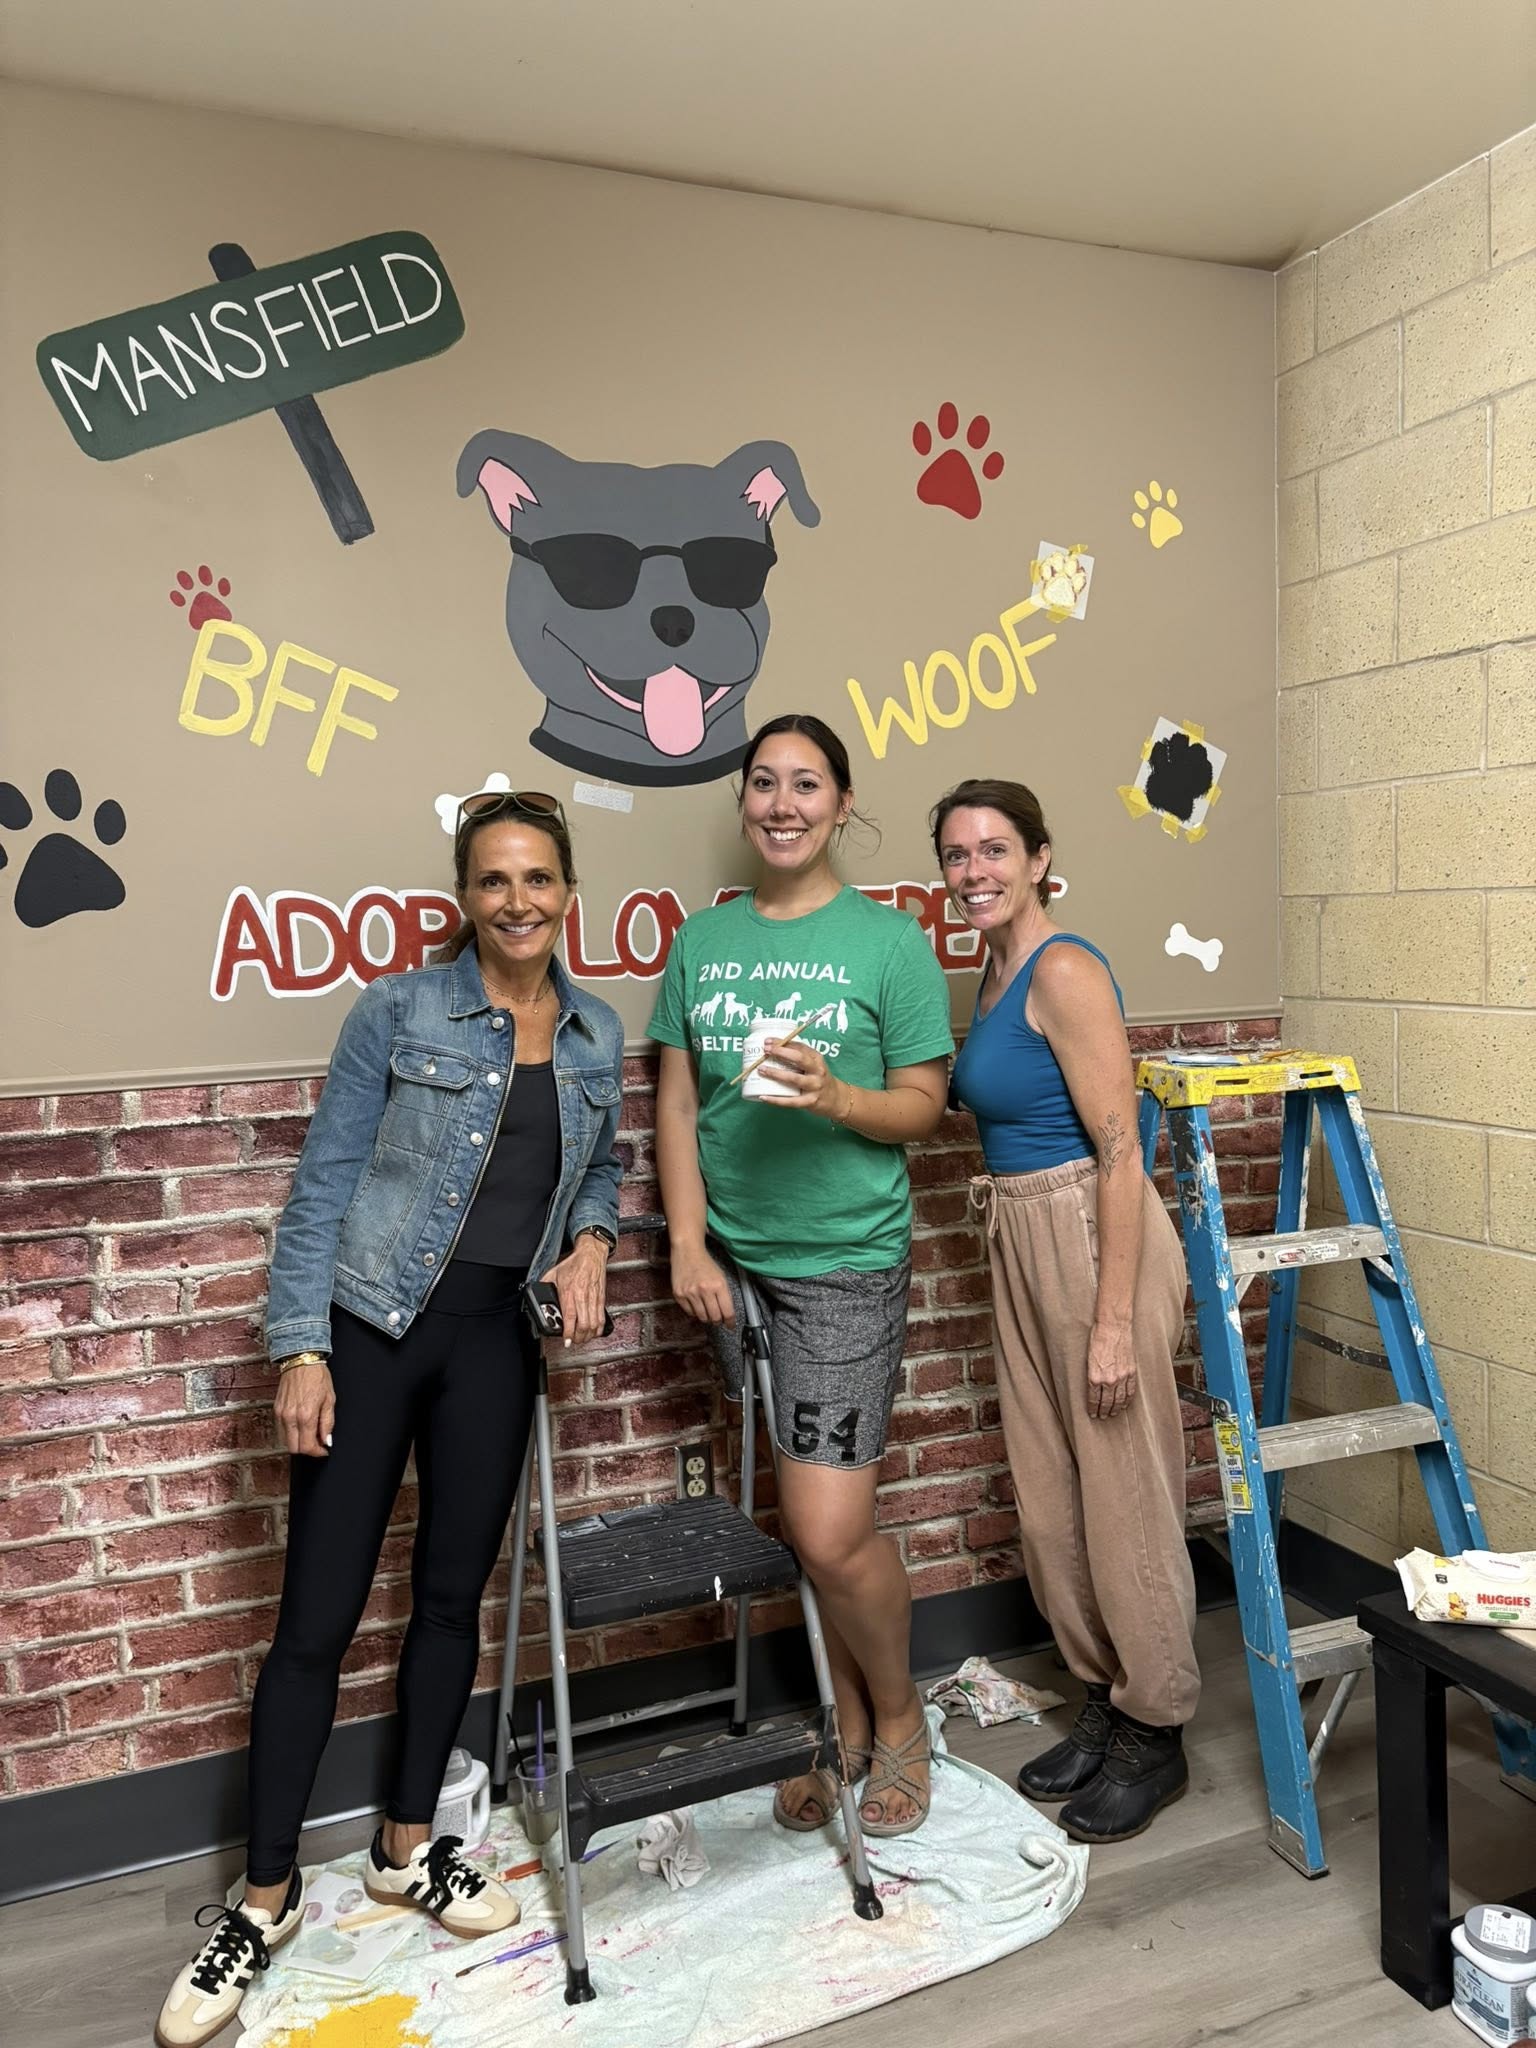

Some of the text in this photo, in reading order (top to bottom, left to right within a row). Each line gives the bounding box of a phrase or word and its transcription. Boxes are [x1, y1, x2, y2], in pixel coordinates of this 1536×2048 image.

[51, 252, 443, 433] MANSFIELD
[178, 618, 400, 777] BFF
[847, 593, 1056, 760] WOOF
[209, 885, 464, 1002] ADOP
[699, 960, 852, 985] 2ND ANNUAL
[791, 1402, 863, 1462] 54
[1477, 1593, 1531, 1607] HUGGIES
